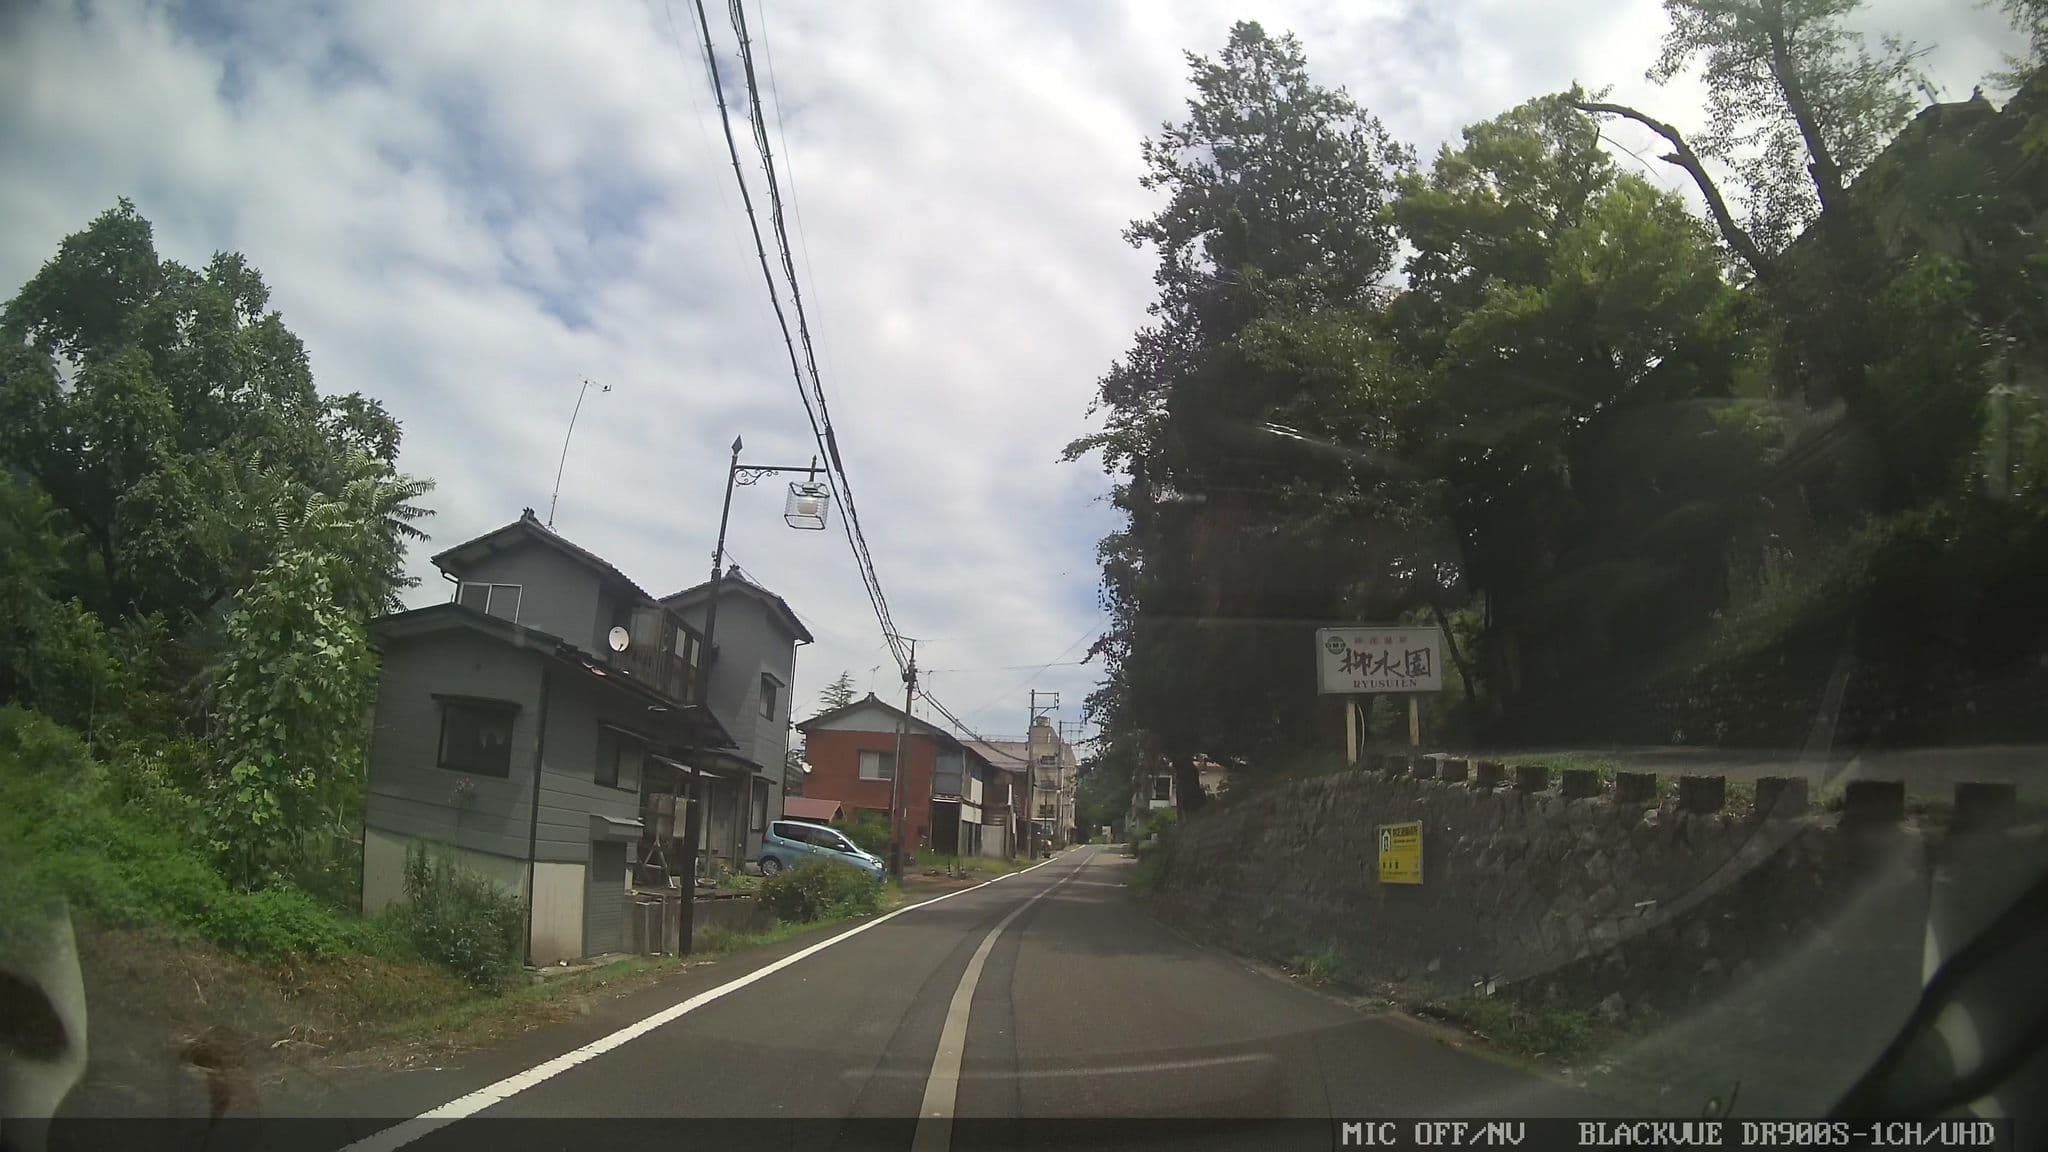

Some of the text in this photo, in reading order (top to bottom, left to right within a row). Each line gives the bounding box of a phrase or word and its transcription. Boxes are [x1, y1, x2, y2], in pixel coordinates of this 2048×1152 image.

[1337, 647, 1432, 678] 柳水園
[1353, 679, 1417, 688] RYUSUIEN
